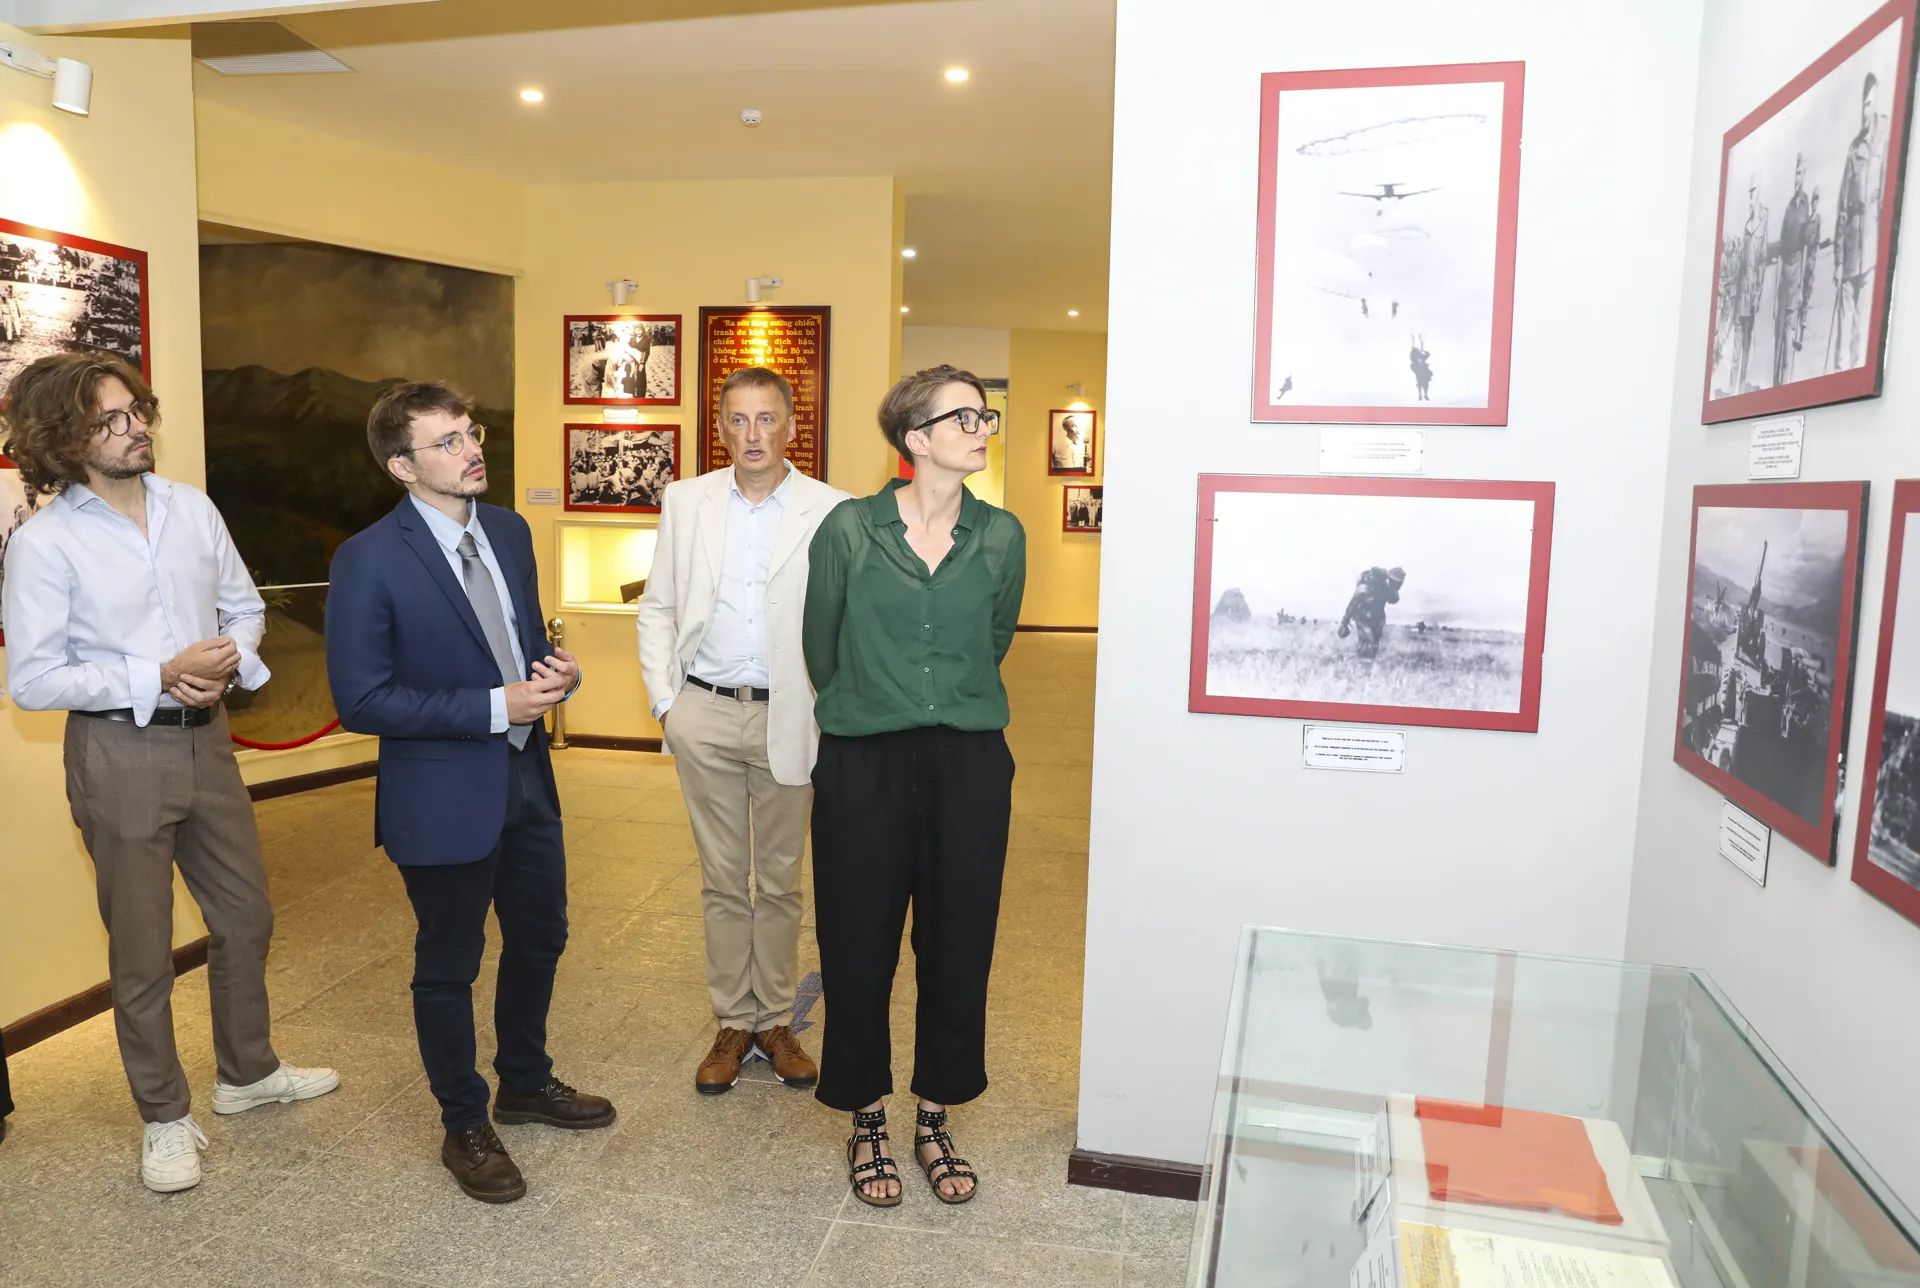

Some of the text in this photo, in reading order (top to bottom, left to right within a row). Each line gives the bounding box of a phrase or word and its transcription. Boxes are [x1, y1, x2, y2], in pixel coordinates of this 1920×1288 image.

[794, 318, 815, 326] chiến
[806, 329, 815, 337] bộ
[774, 338, 791, 346] địch
[766, 346, 772, 354] ở
[774, 346, 788, 354] Bắc
[790, 348, 800, 356] Bộ
[730, 357, 753, 365] Trung
[796, 357, 808, 365] Bộ.
[800, 366, 815, 375] nắm
[800, 431, 814, 441] yếu,
[713, 459, 725, 467] vận
